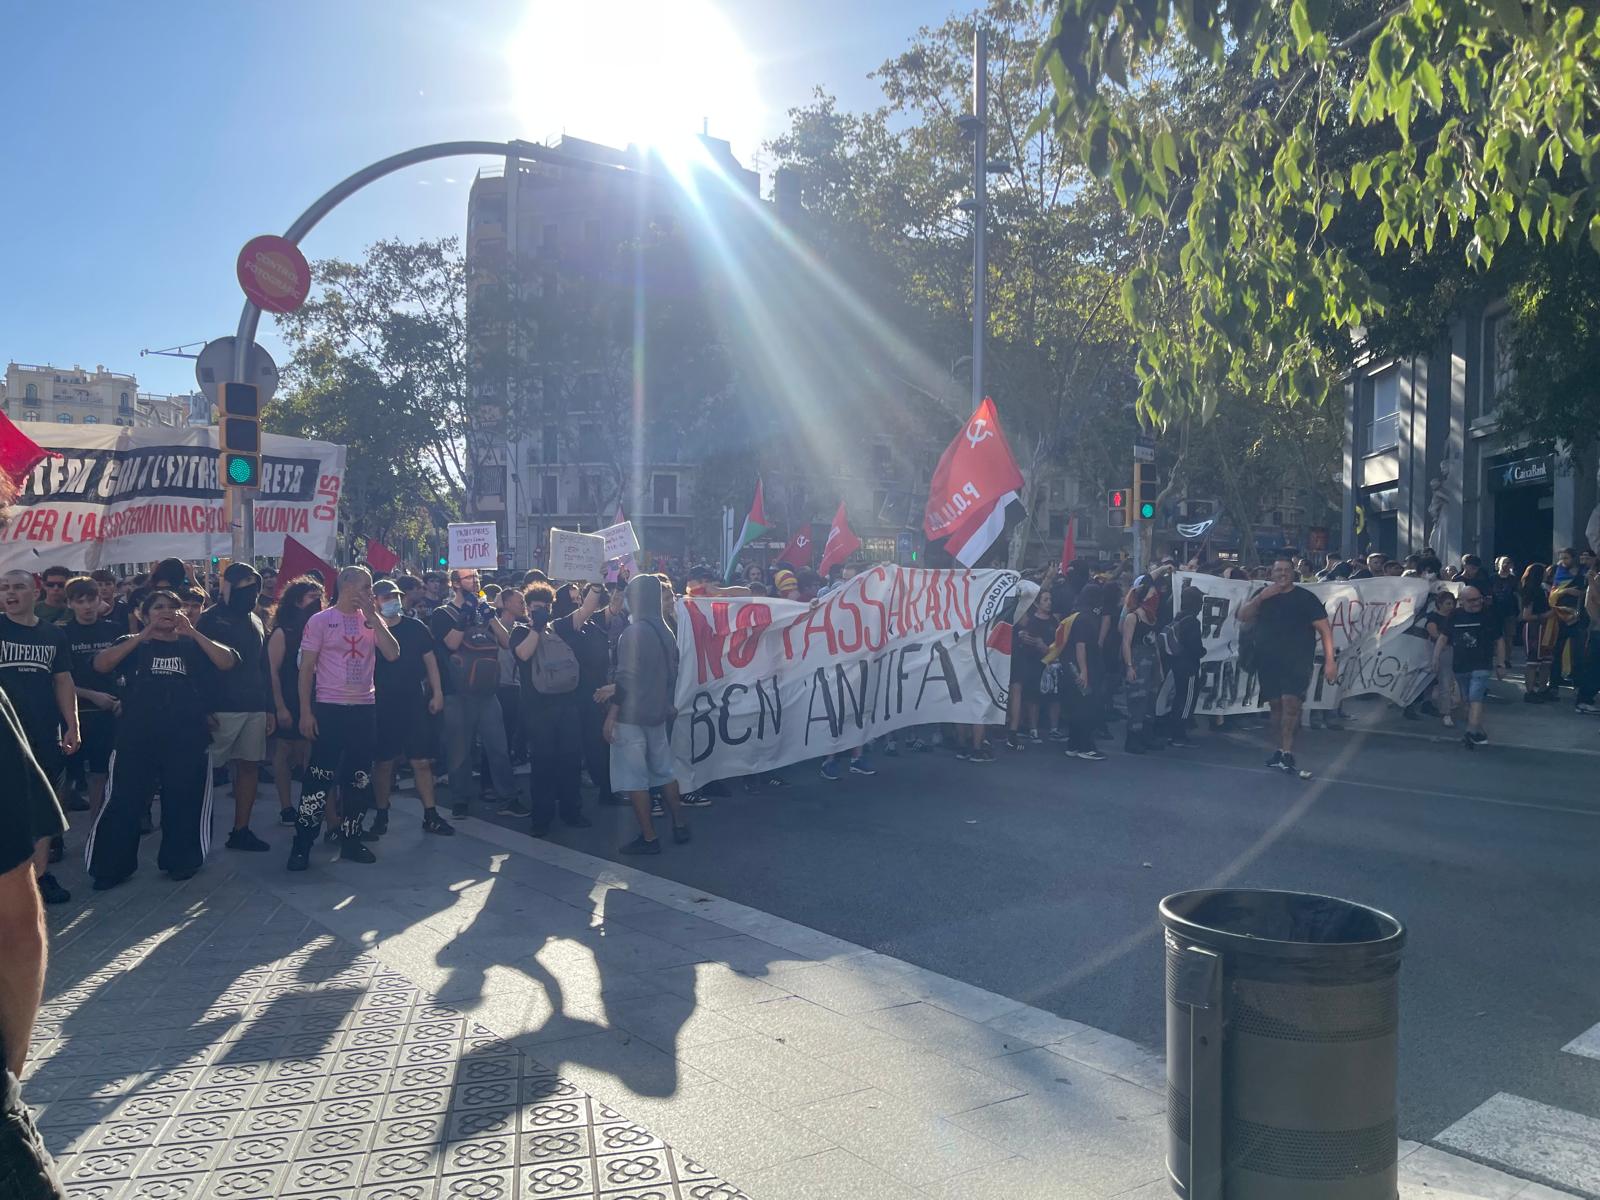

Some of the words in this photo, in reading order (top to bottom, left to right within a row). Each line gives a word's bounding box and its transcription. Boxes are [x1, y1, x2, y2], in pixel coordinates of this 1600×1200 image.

[151, 455, 222, 491] L'EXTRE
[260, 462, 304, 494] RETA
[1514, 463, 1546, 480] CaixaBank
[12, 509, 59, 542] PER
[684, 601, 773, 685] NO
[690, 674, 782, 764] BCN
[804, 640, 963, 746] ANTIFA
